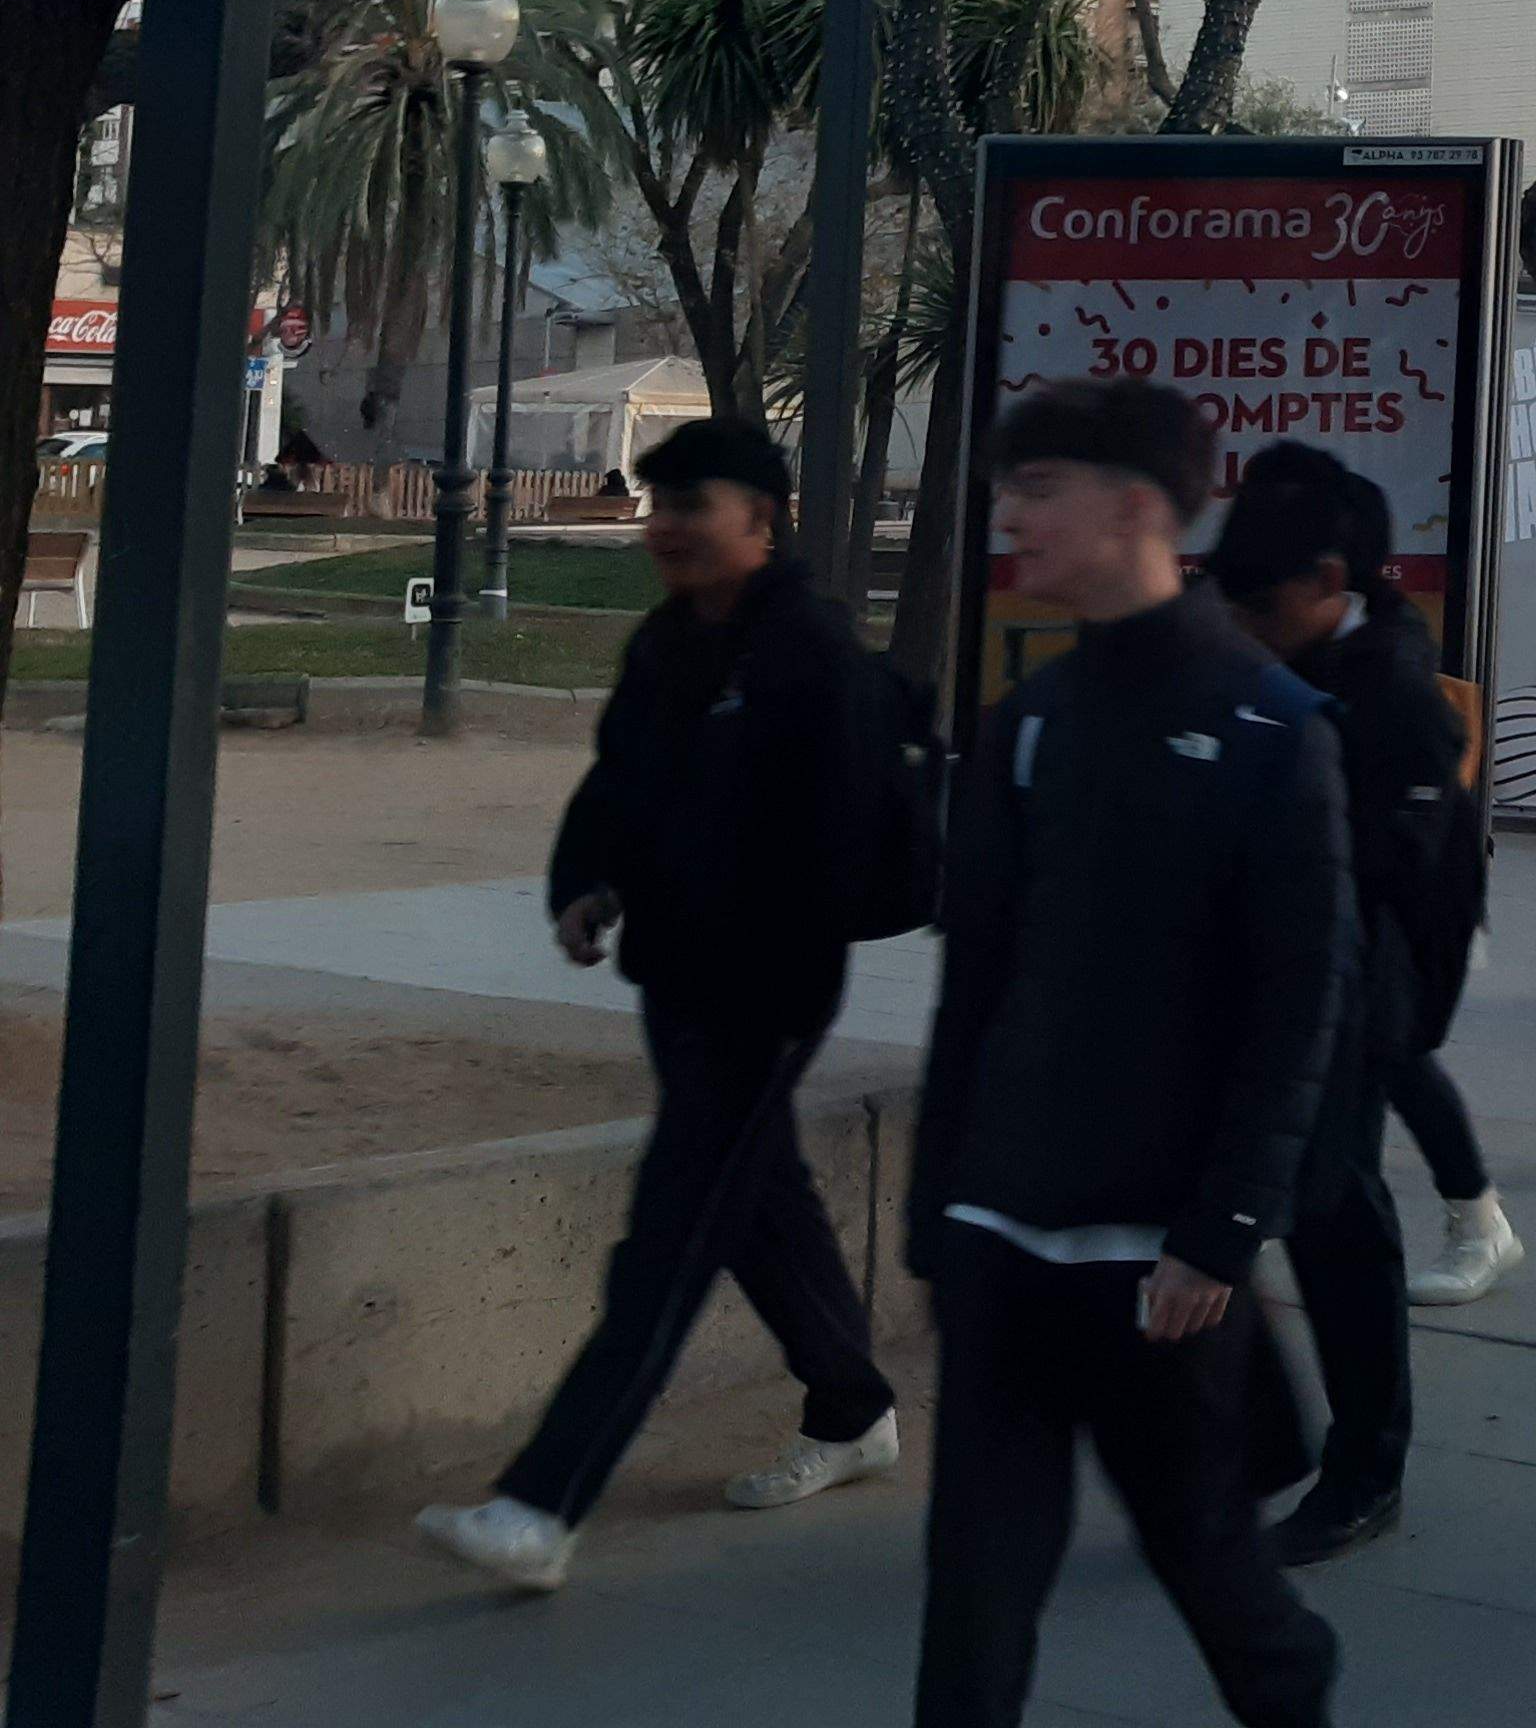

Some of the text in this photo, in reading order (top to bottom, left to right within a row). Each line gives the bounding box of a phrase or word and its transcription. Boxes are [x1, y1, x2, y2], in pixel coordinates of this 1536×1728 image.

[1362, 150, 1404, 160] ALPHA
[1031, 192, 1446, 260] Conforama 30 anys
[1089, 338, 1372, 378] 30 DIES DE
[1194, 392, 1405, 433] OMPTES
